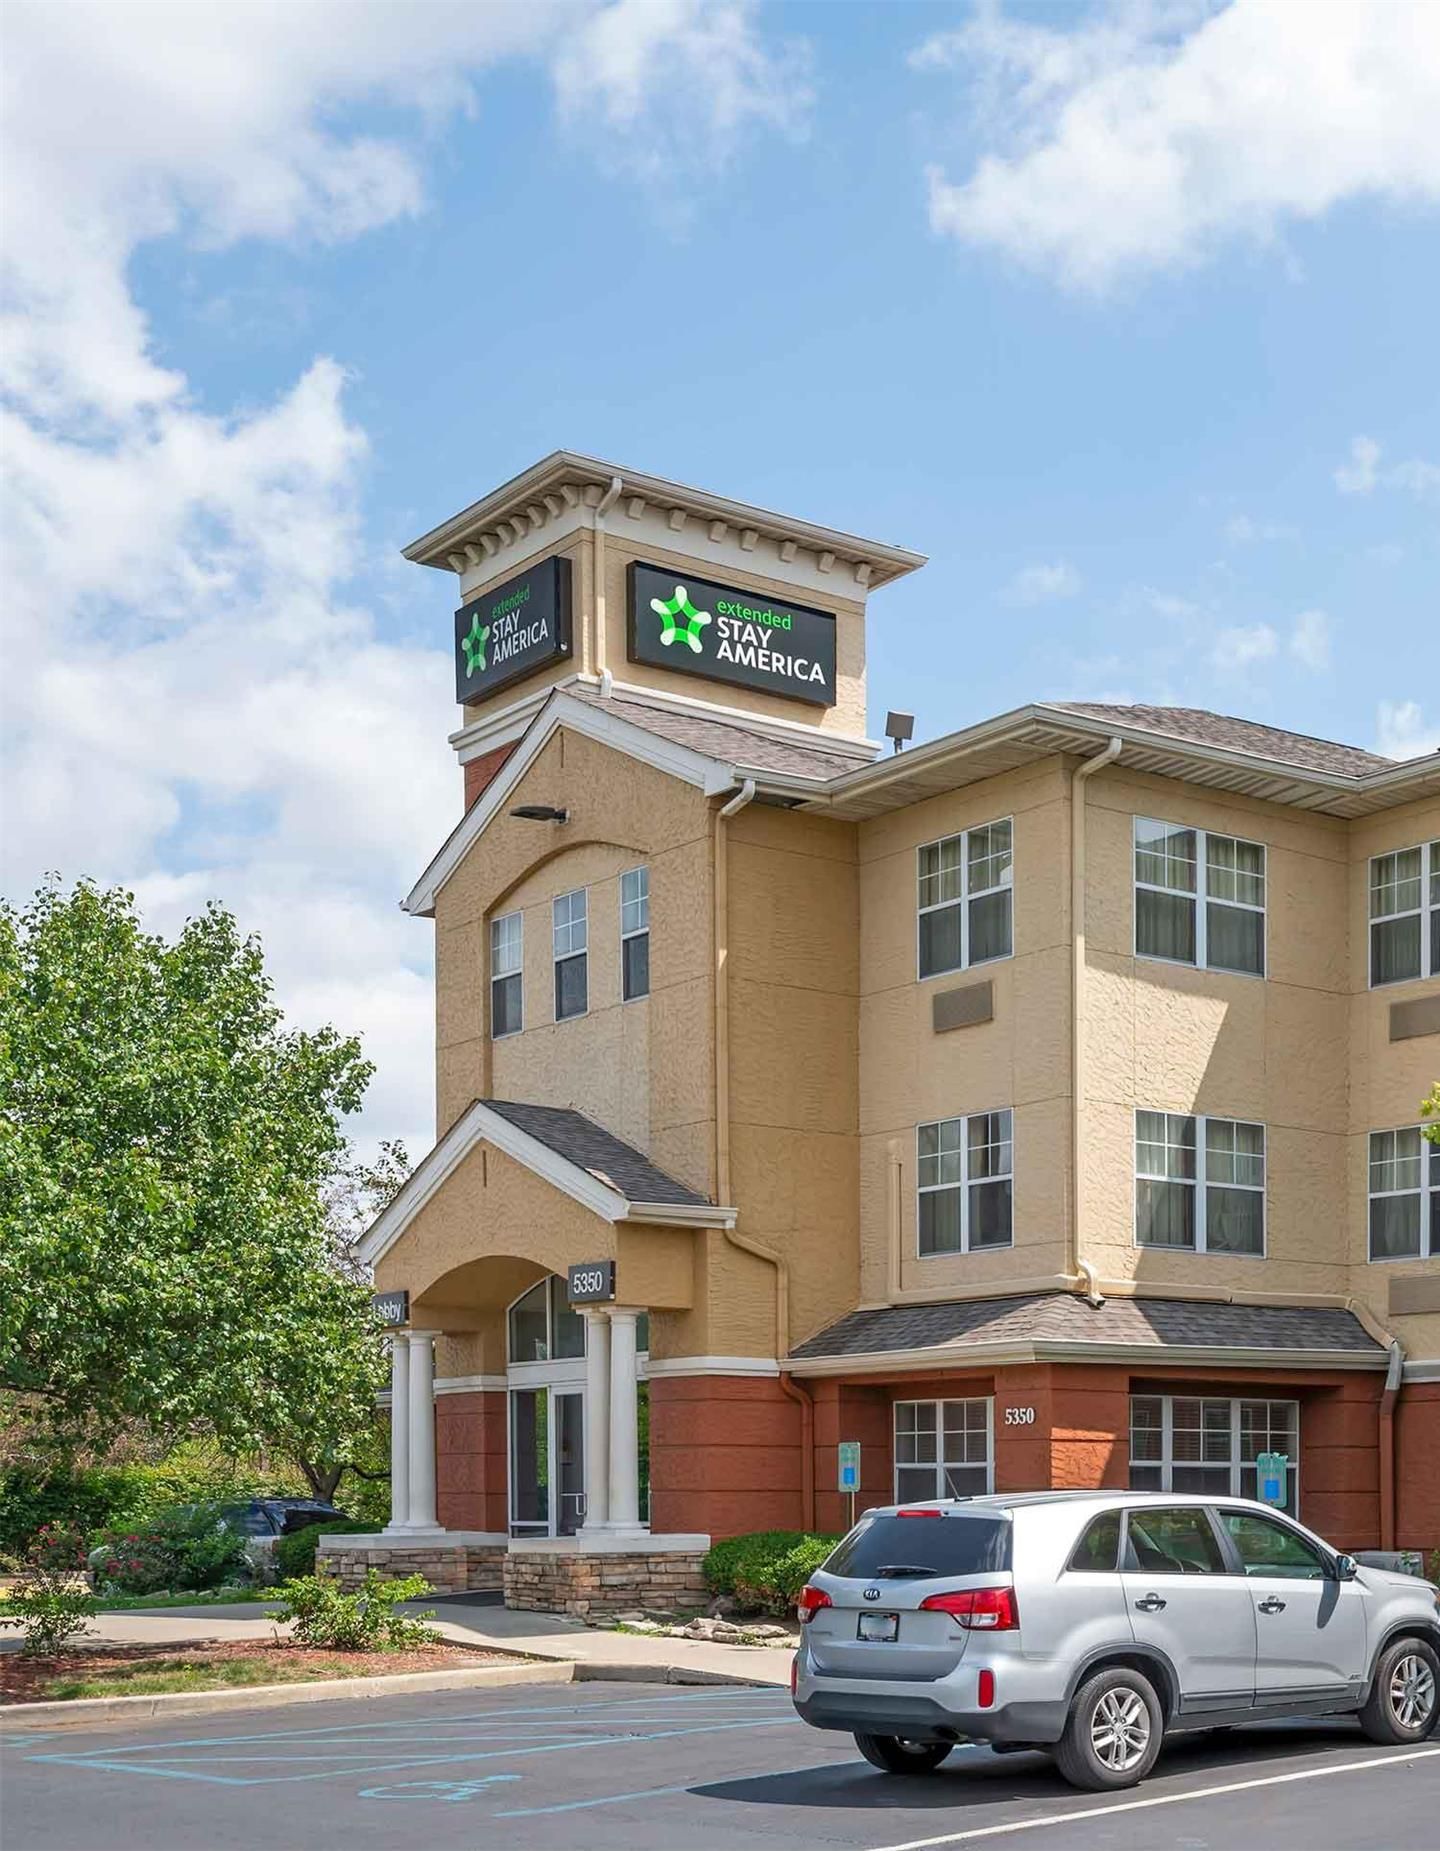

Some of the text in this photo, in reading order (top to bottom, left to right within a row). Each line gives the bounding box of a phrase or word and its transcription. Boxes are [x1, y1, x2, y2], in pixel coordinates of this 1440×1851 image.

[492, 608, 521, 644] STAY
[717, 600, 792, 631] extended
[492, 617, 549, 666] AMERICA
[717, 616, 773, 649] STAY
[716, 639, 826, 686] AMERICA
[573, 1271, 603, 1294] 5350
[1005, 1407, 1035, 1425] 5350
[865, 1590, 879, 1599] KIA
